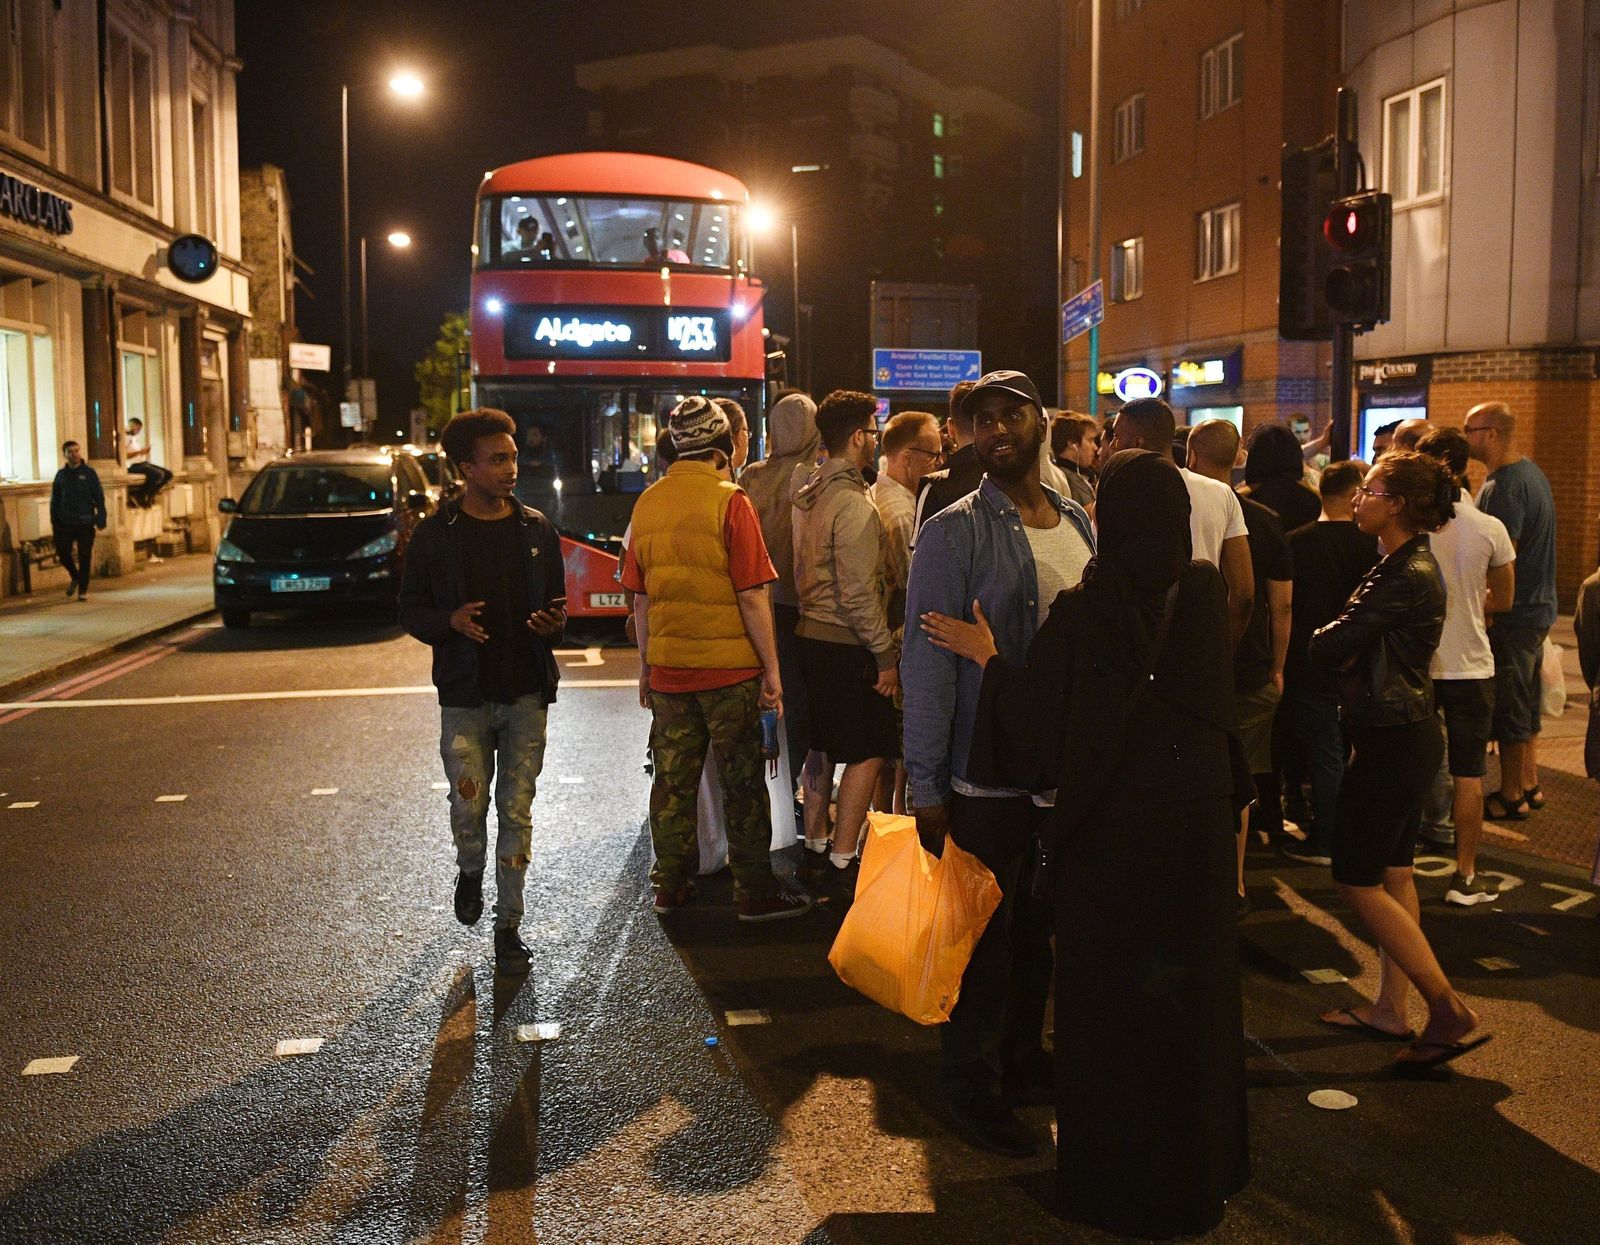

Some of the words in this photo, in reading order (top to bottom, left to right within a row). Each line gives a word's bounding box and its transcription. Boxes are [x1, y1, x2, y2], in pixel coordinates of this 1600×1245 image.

[0, 173, 73, 235] ARCLAYS
[535, 317, 632, 347] Aldgate
[891, 352, 917, 361] Arsenal
[919, 353, 947, 361] Football
[948, 353, 966, 361] Club
[599, 595, 621, 605] LTZ
